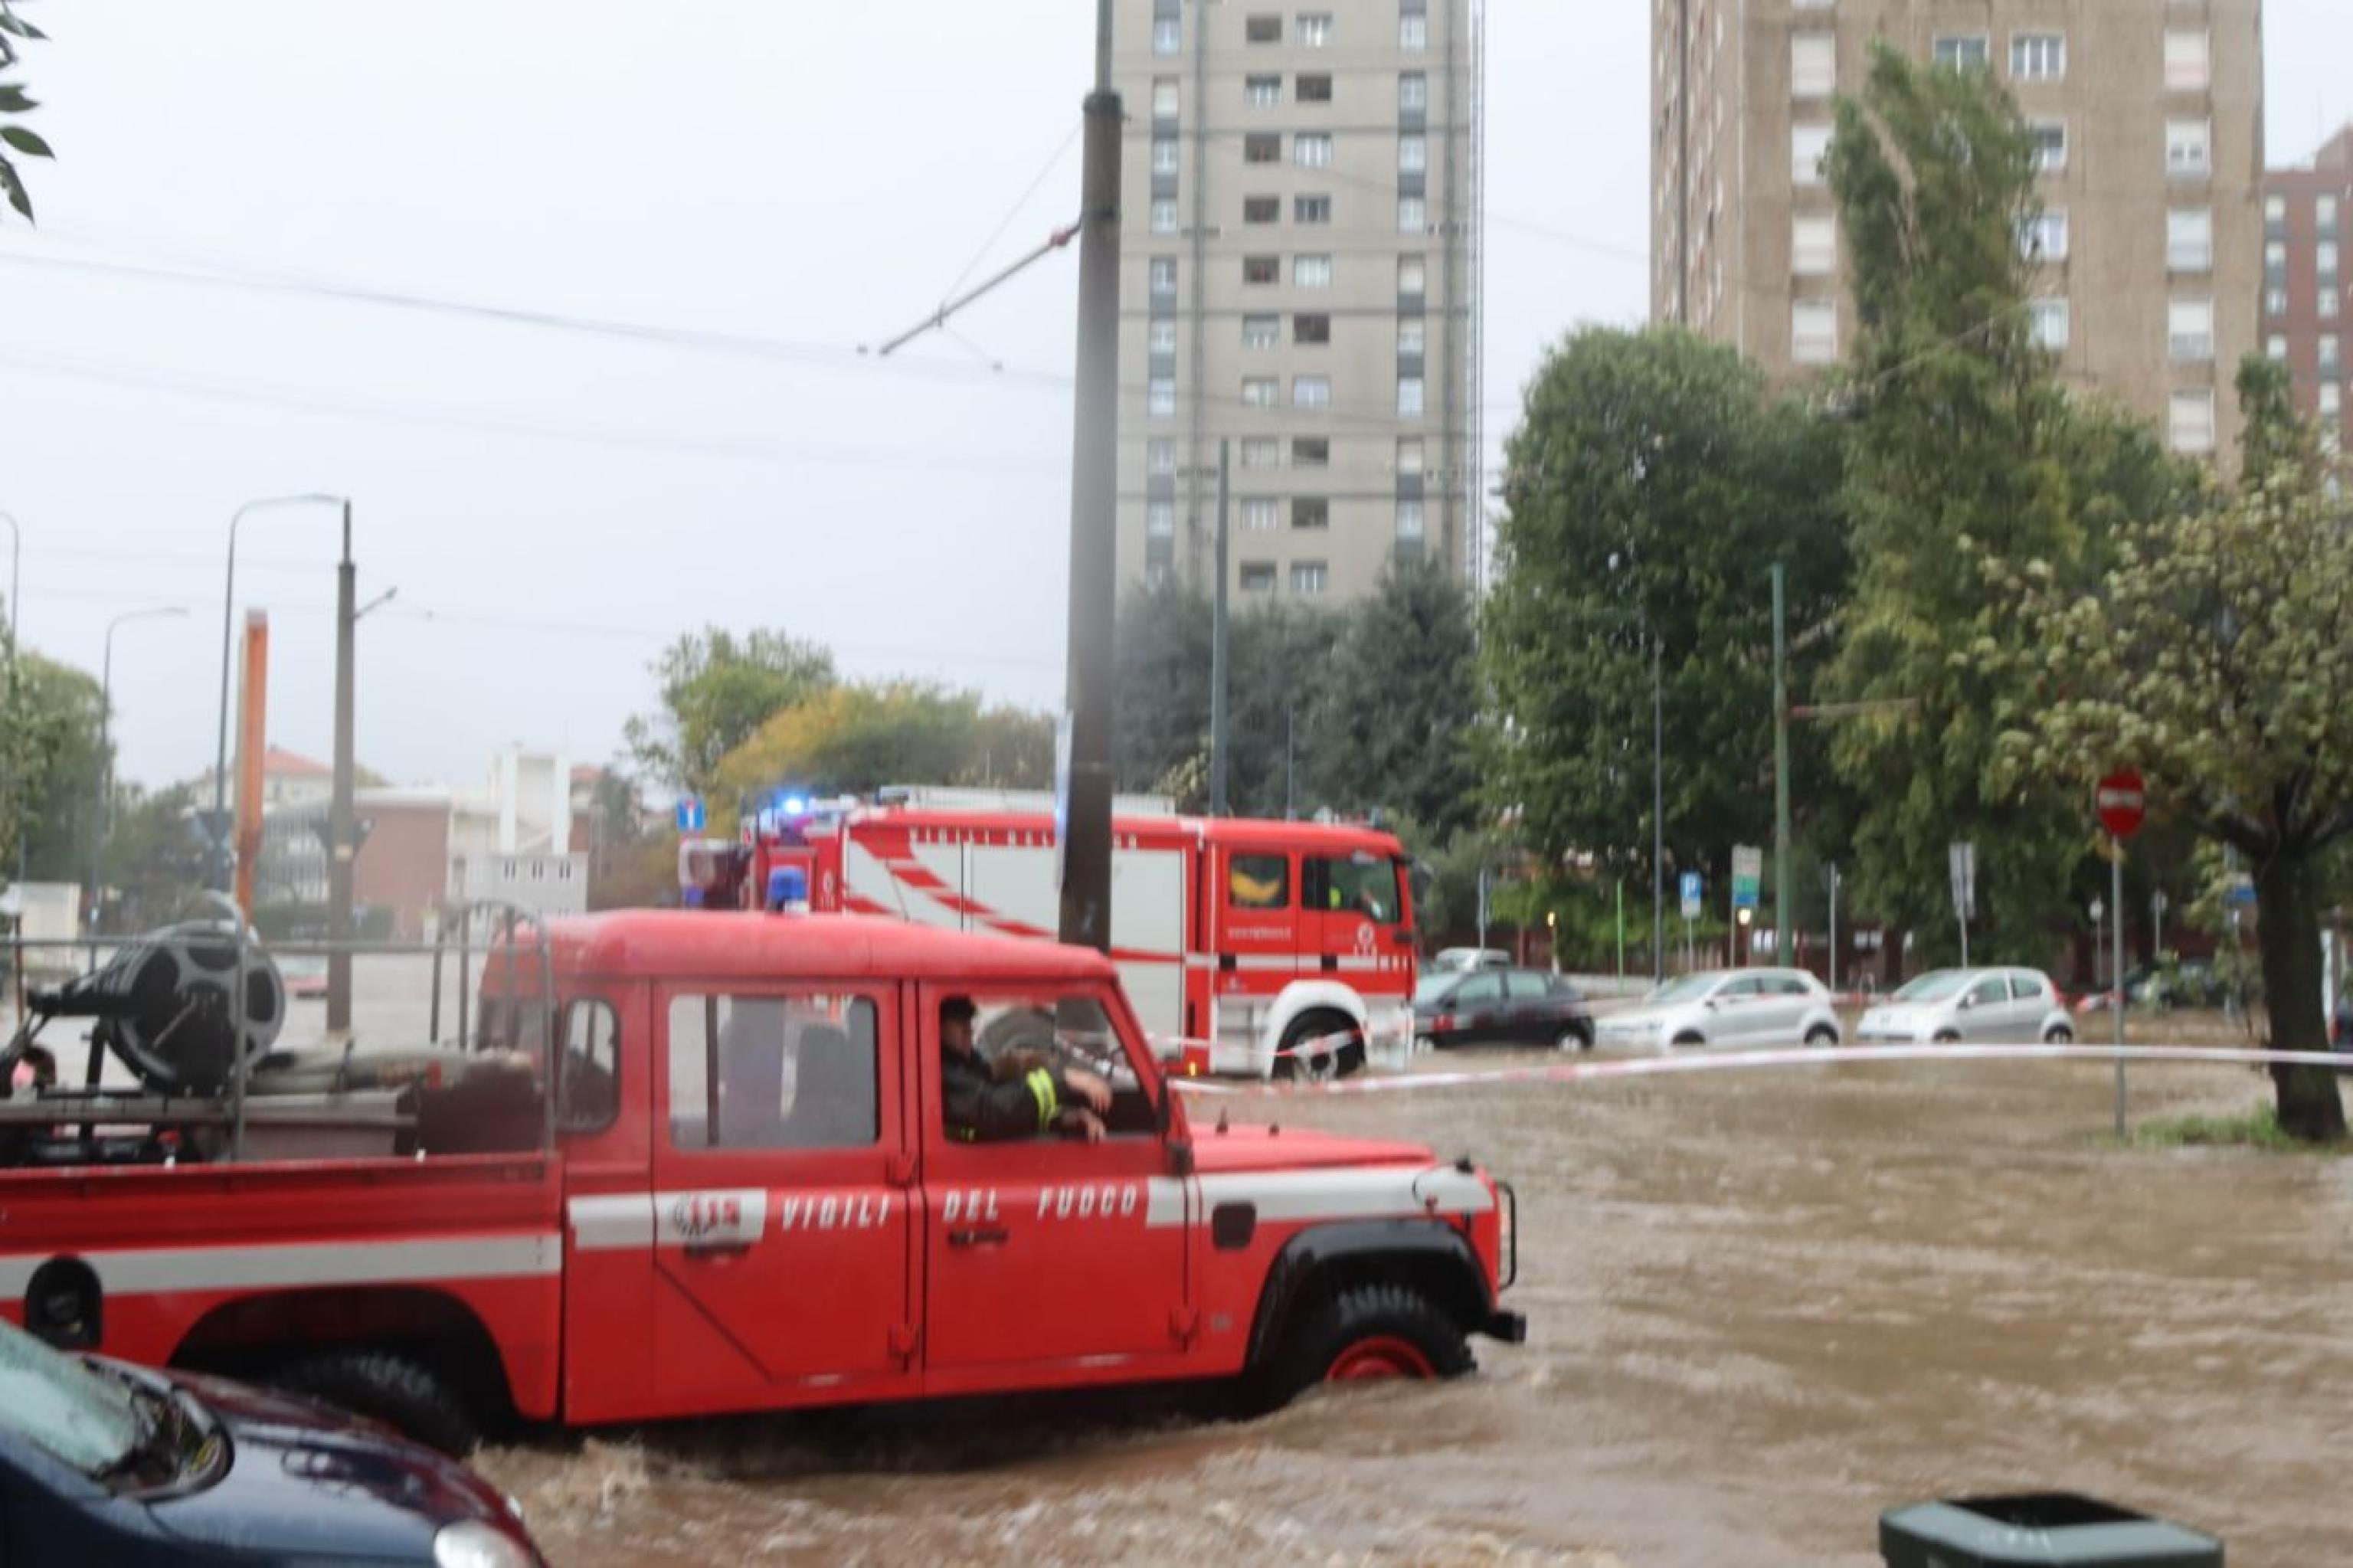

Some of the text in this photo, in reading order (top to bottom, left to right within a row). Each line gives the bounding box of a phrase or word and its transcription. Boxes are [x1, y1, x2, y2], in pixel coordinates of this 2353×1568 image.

[782, 1184, 1137, 1232] VIGILI DEL FUOCO
